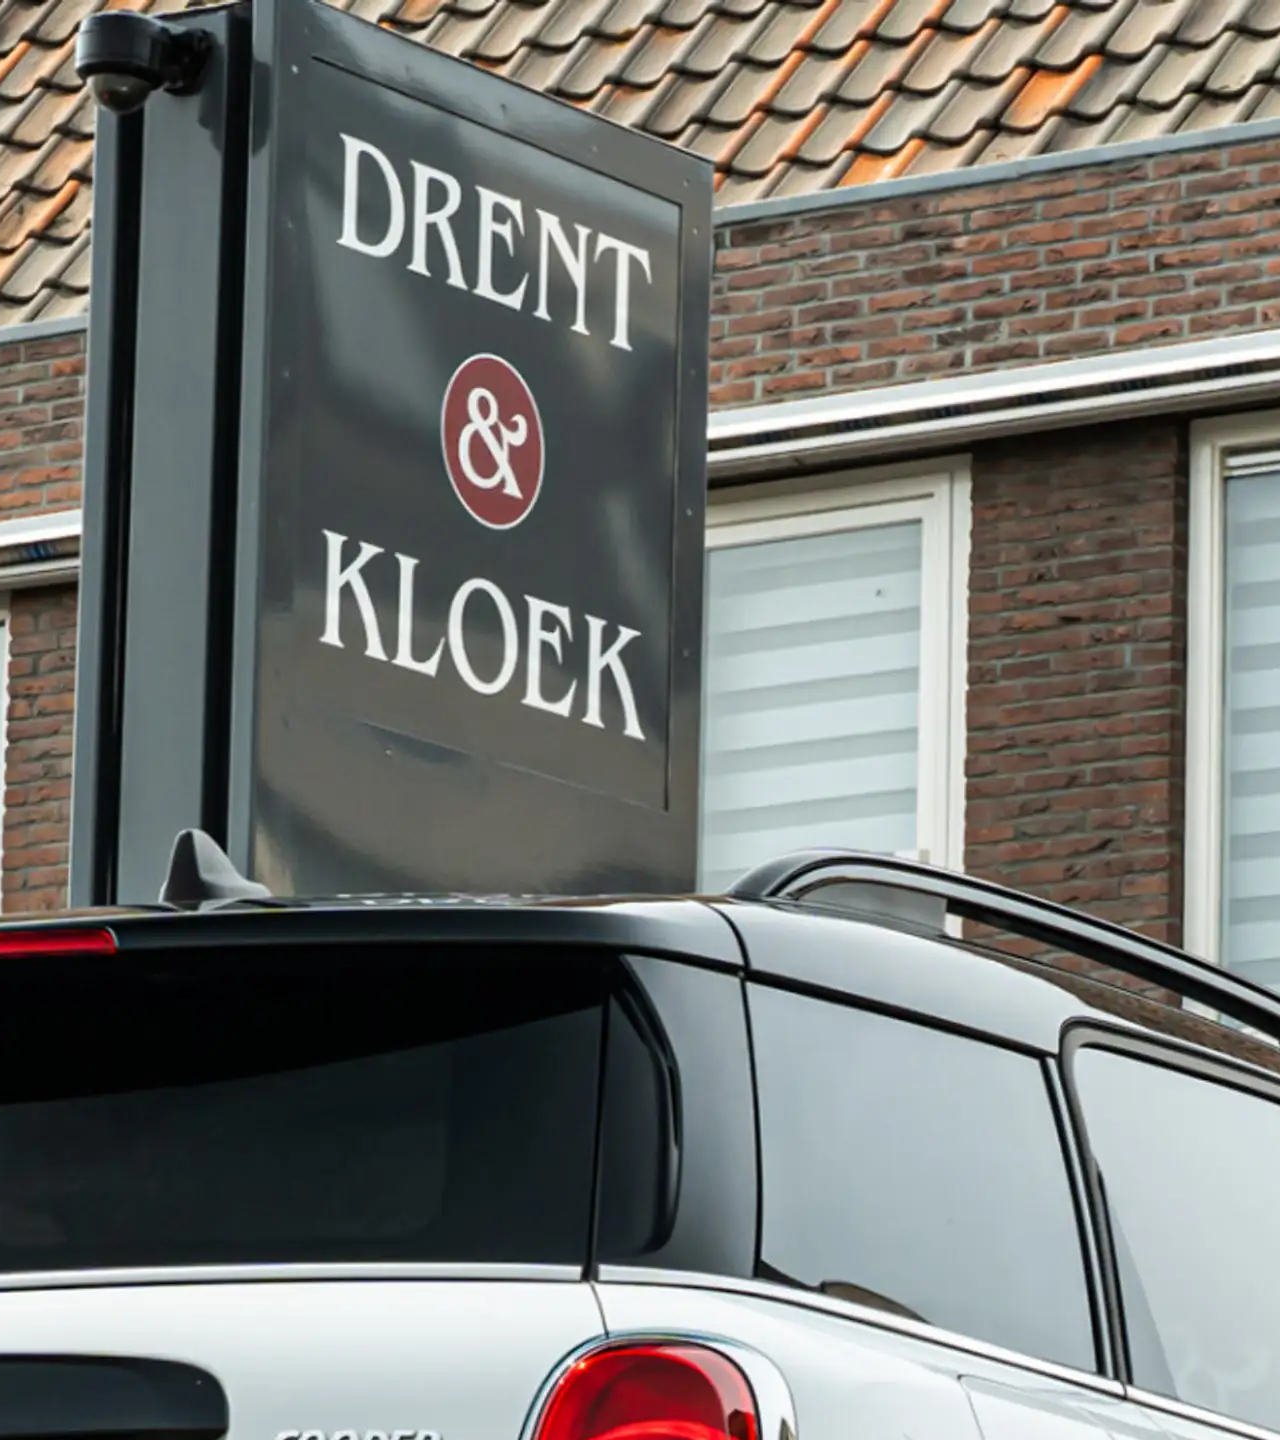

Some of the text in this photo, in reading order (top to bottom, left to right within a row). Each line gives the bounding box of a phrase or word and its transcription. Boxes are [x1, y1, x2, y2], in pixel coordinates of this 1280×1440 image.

[336, 132, 652, 352] DRENT
[458, 387, 528, 499] &
[319, 529, 646, 741] KLOEK
